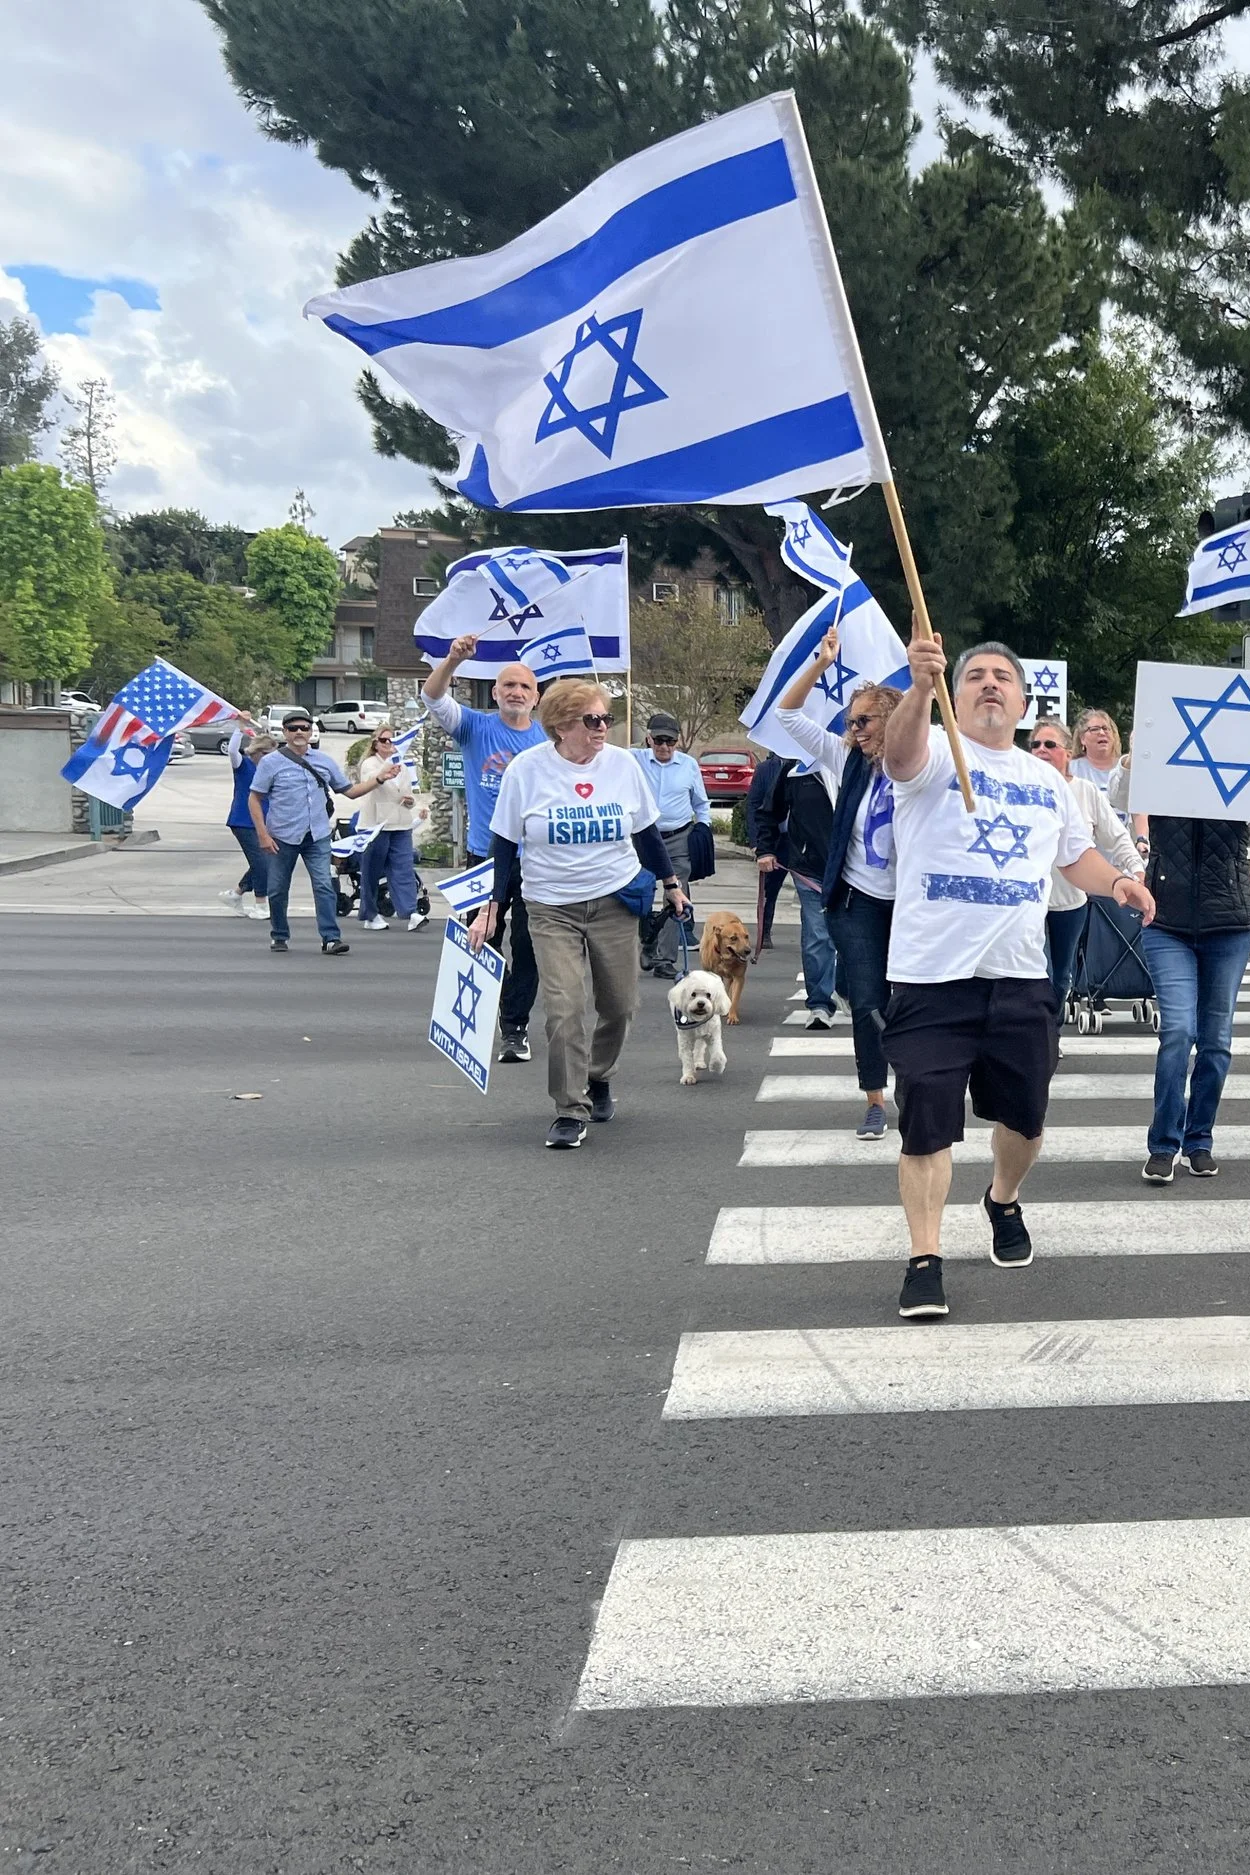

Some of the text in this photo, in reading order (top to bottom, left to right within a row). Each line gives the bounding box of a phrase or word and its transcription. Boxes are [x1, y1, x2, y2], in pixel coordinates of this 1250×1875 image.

[548, 803, 624, 820] I stand with
[548, 819, 625, 845] ISRAEL
[454, 926, 497, 974] WE AND
[433, 1025, 484, 1087] WITH ISRAEL
